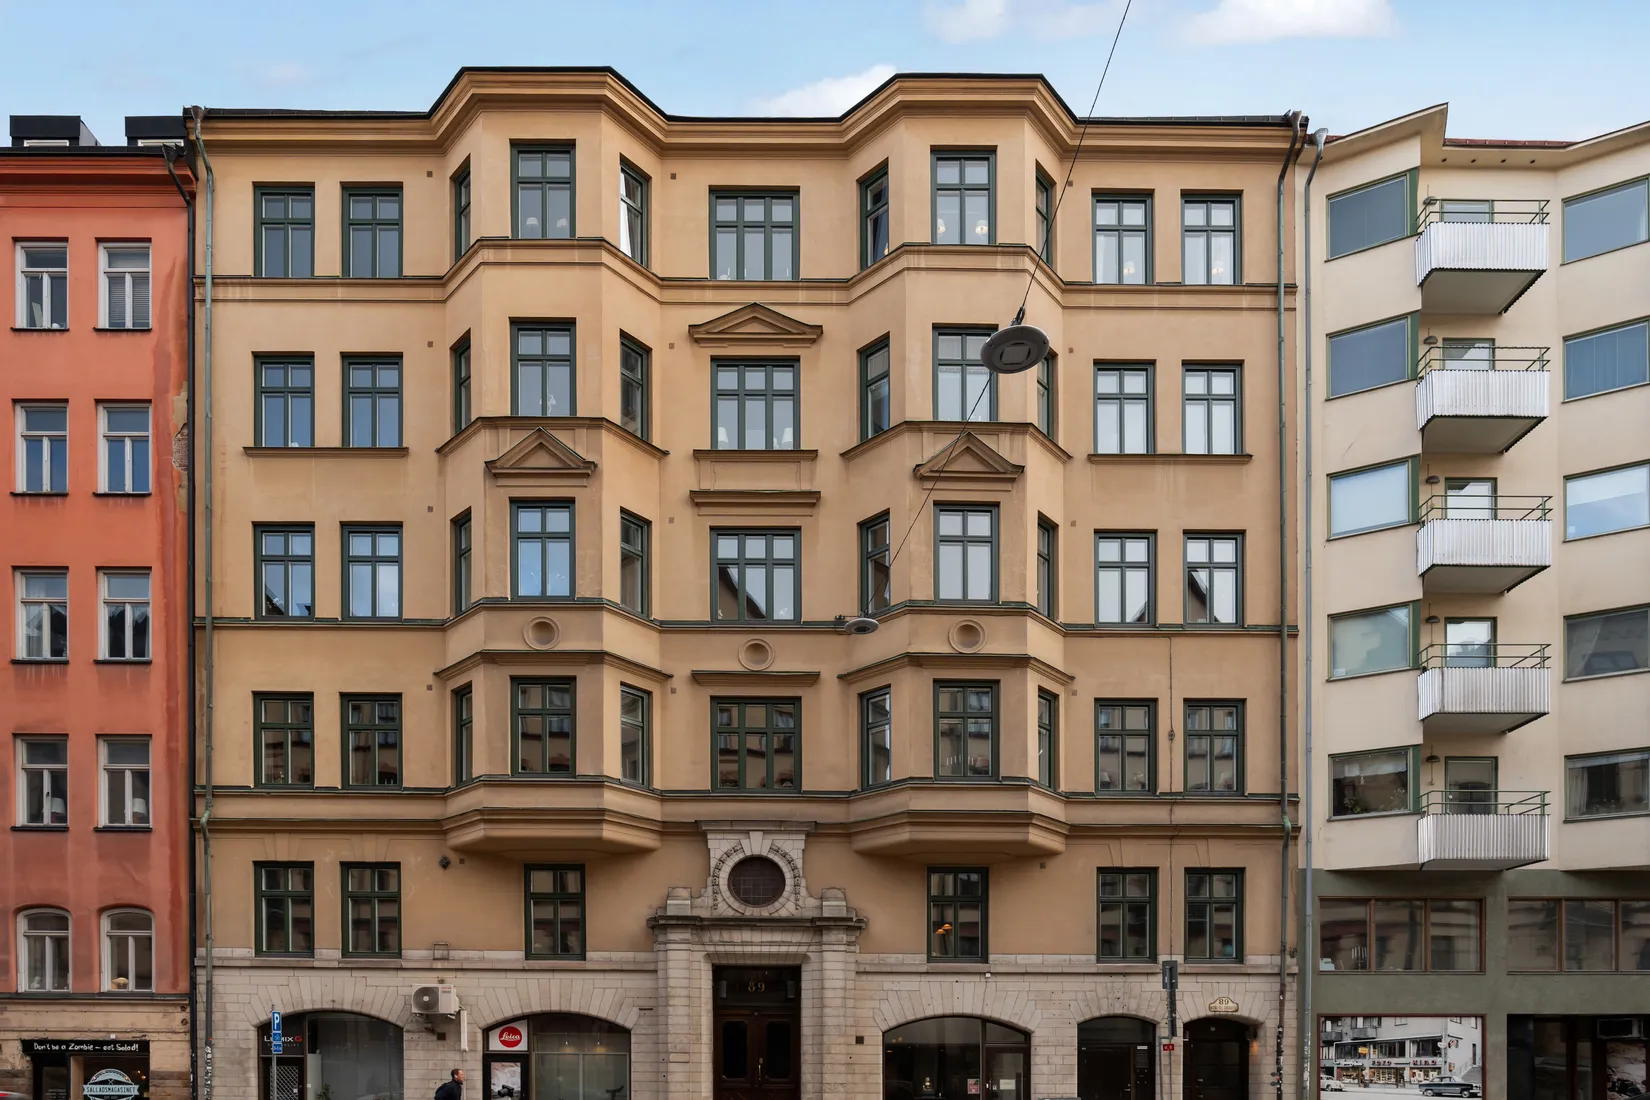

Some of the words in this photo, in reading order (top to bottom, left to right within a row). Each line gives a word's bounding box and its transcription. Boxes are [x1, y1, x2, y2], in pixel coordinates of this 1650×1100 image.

[748, 981, 765, 992] 89
[274, 1013, 280, 1030] P
[500, 1031, 520, 1041] Leica
[33, 1042, 51, 1051] Don't
[51, 1043, 60, 1051] be
[68, 1042, 94, 1051] Zombie
[103, 1043, 115, 1051] eat
[116, 1043, 139, 1052] Salad!
